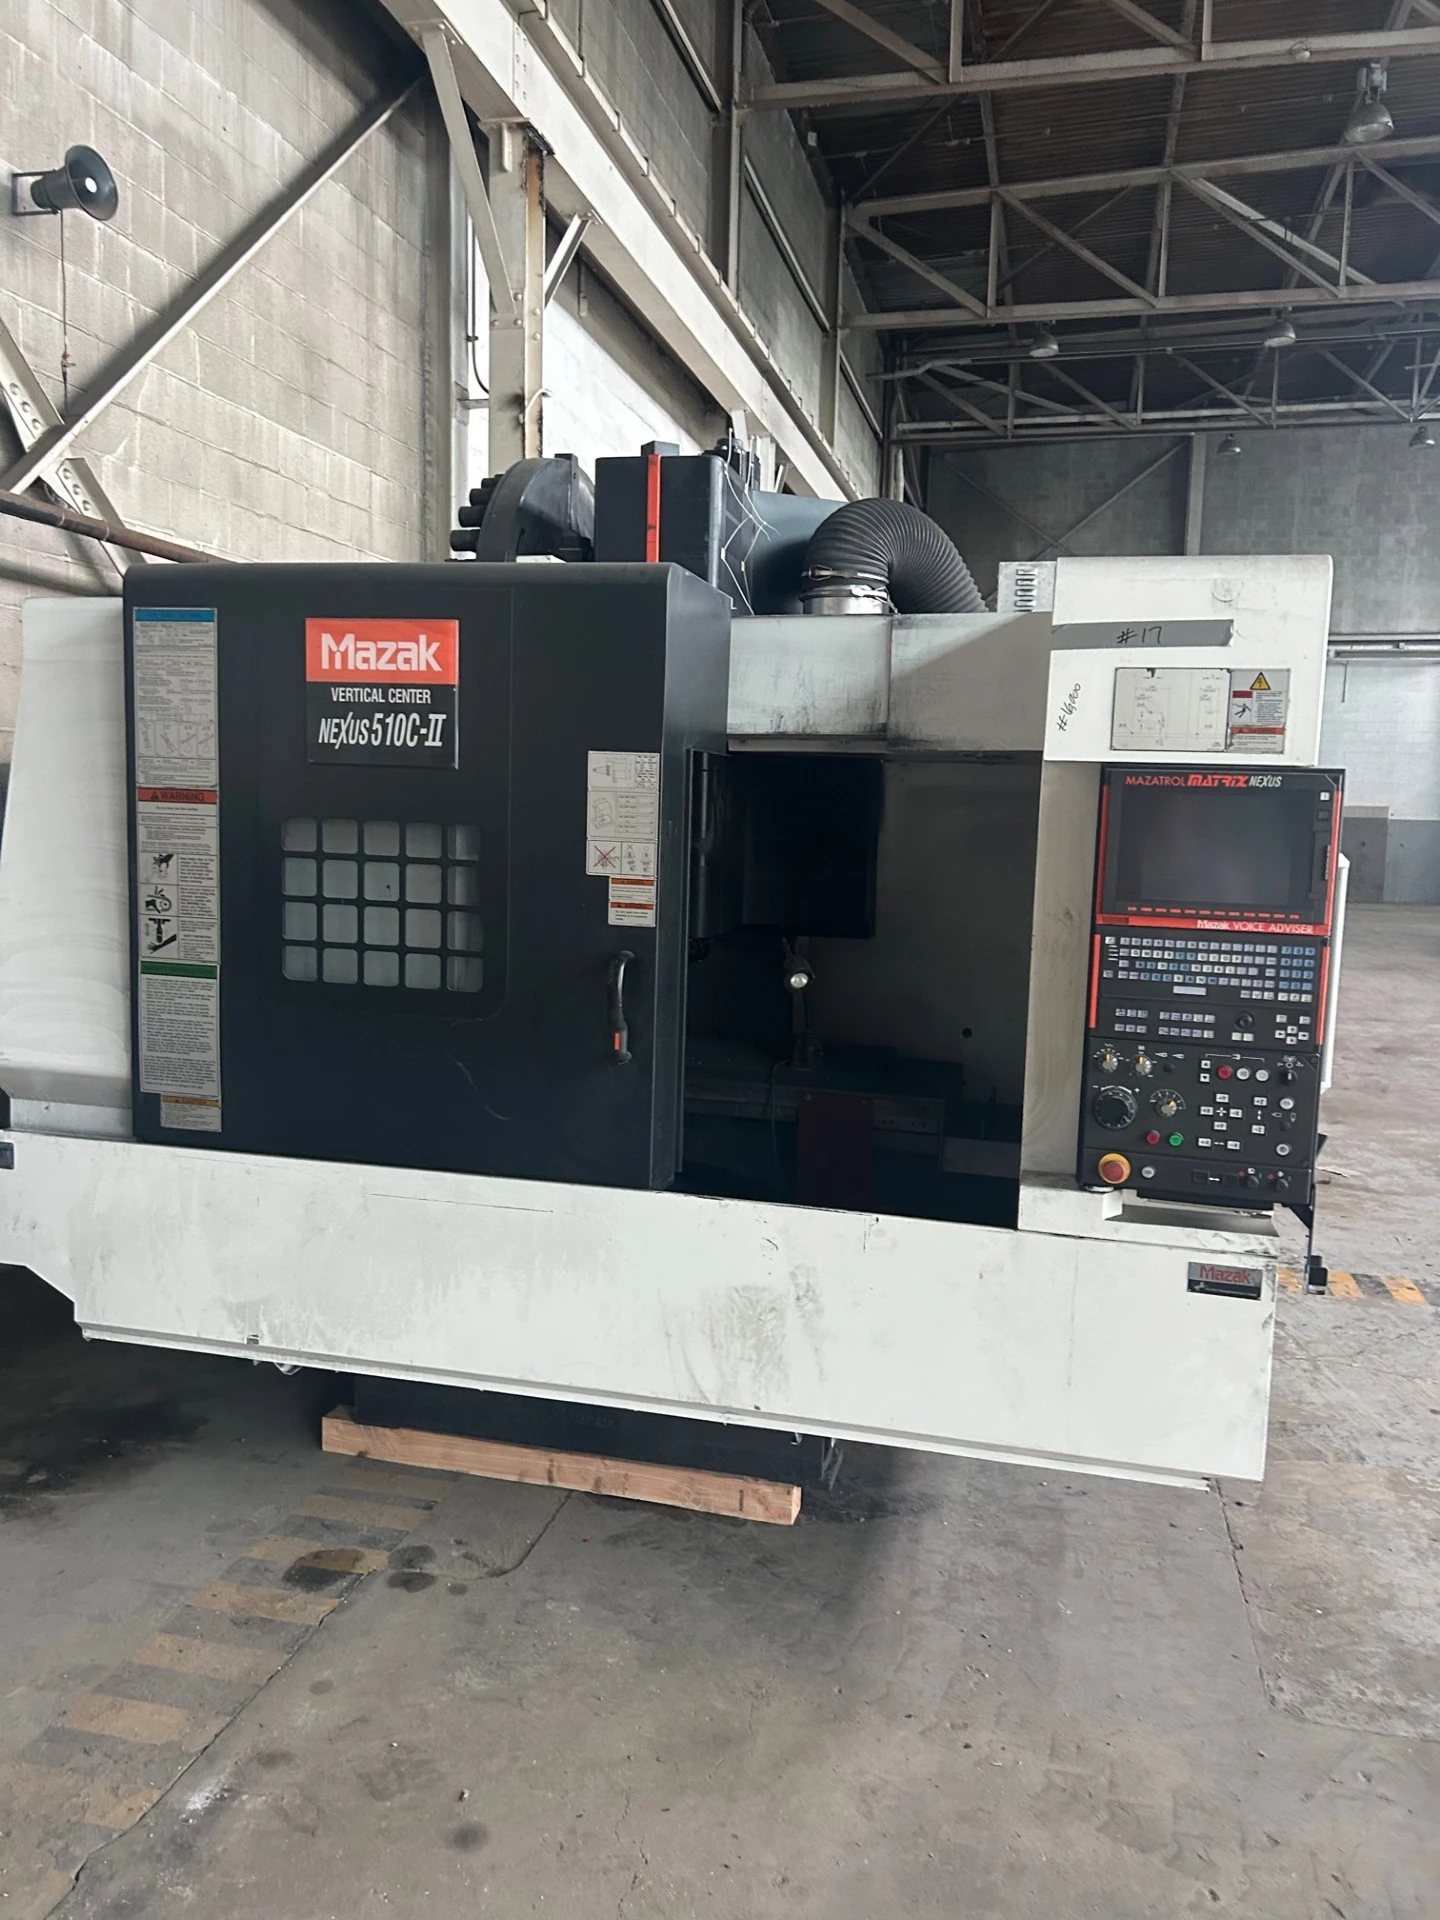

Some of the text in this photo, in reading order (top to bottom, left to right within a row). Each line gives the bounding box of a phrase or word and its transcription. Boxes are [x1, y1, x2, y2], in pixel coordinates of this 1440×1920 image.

[1116, 625, 1162, 644] #17
[321, 633, 442, 672] Mazak
[331, 687, 432, 704] VERTICAL CENTER
[1125, 775, 1186, 787] MAZATROL
[1249, 775, 1283, 788] NEXUS
[1196, 919, 1314, 934] Mazak VOICE ADVISER
[1199, 1265, 1252, 1285] Mazak
